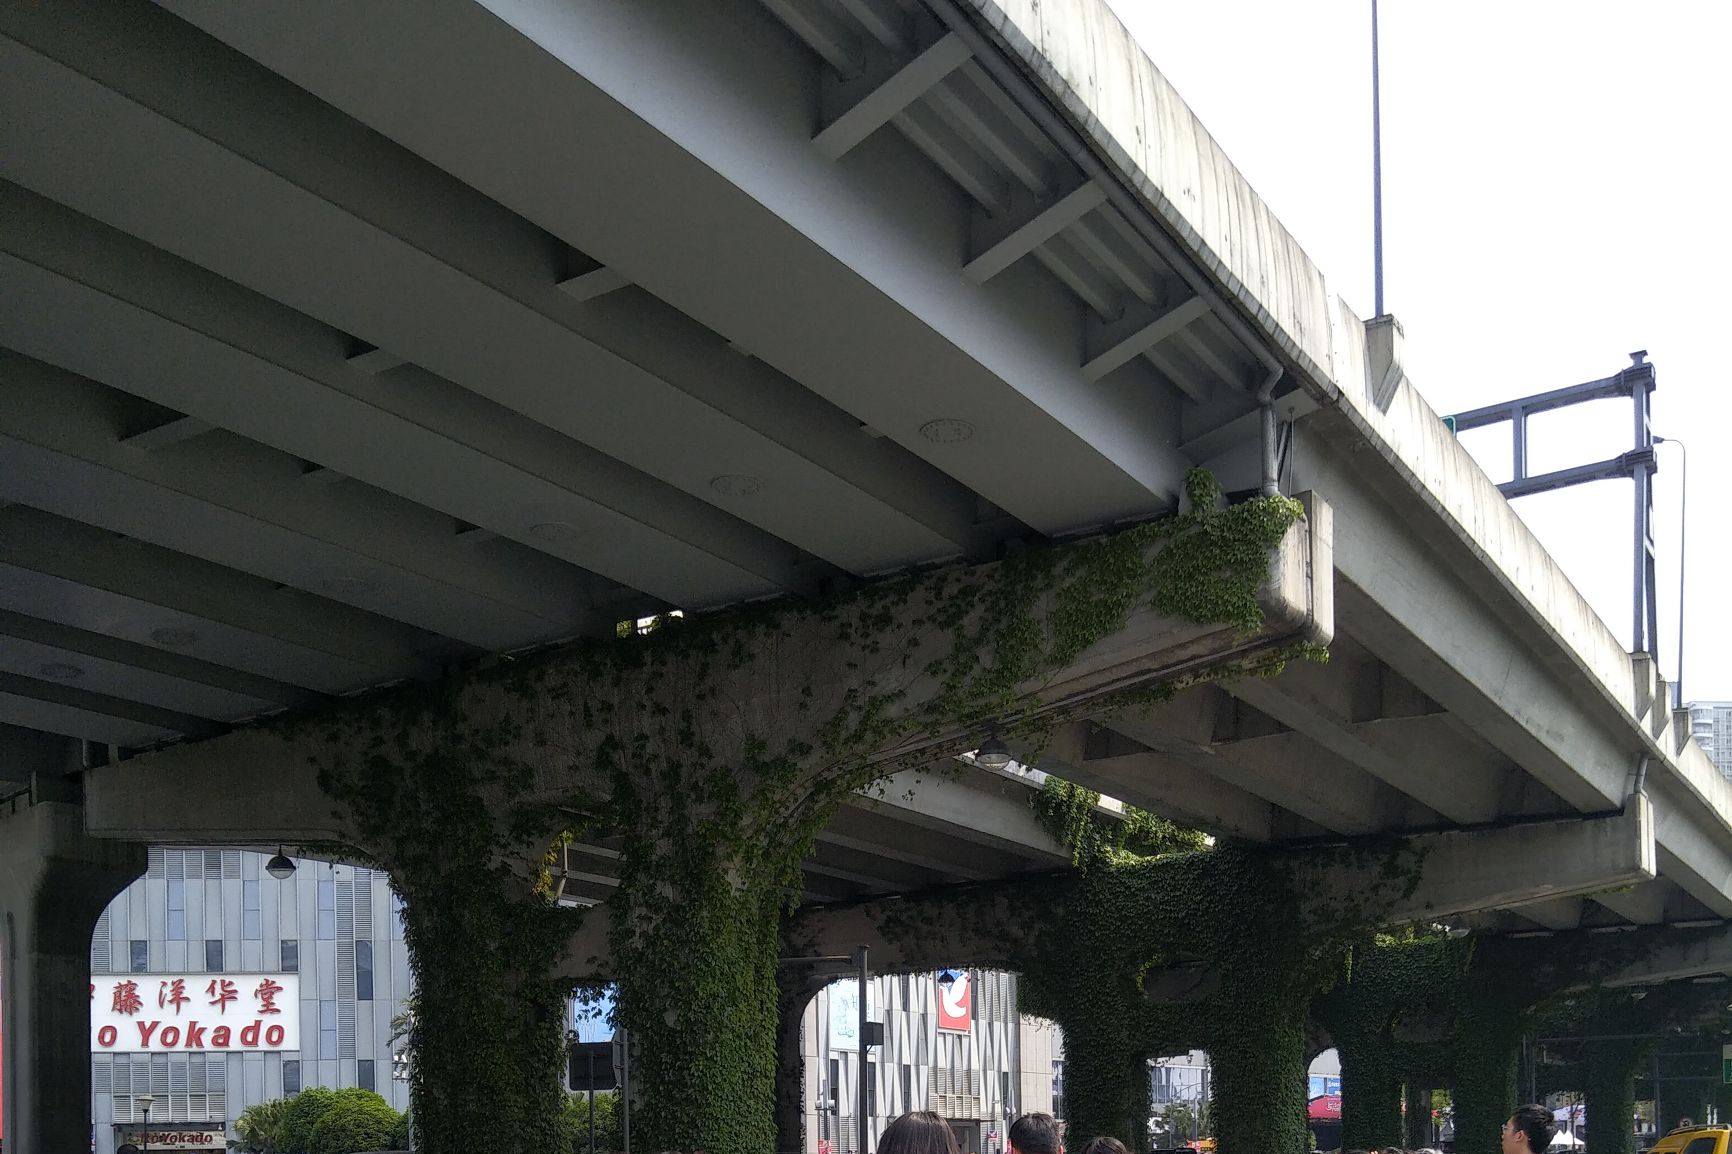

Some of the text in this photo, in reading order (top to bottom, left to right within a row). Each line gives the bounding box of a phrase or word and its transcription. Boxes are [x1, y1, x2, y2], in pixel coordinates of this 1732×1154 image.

[90, 978, 284, 1015] 藤洋华堂
[136, 1020, 285, 1048] Yokado
